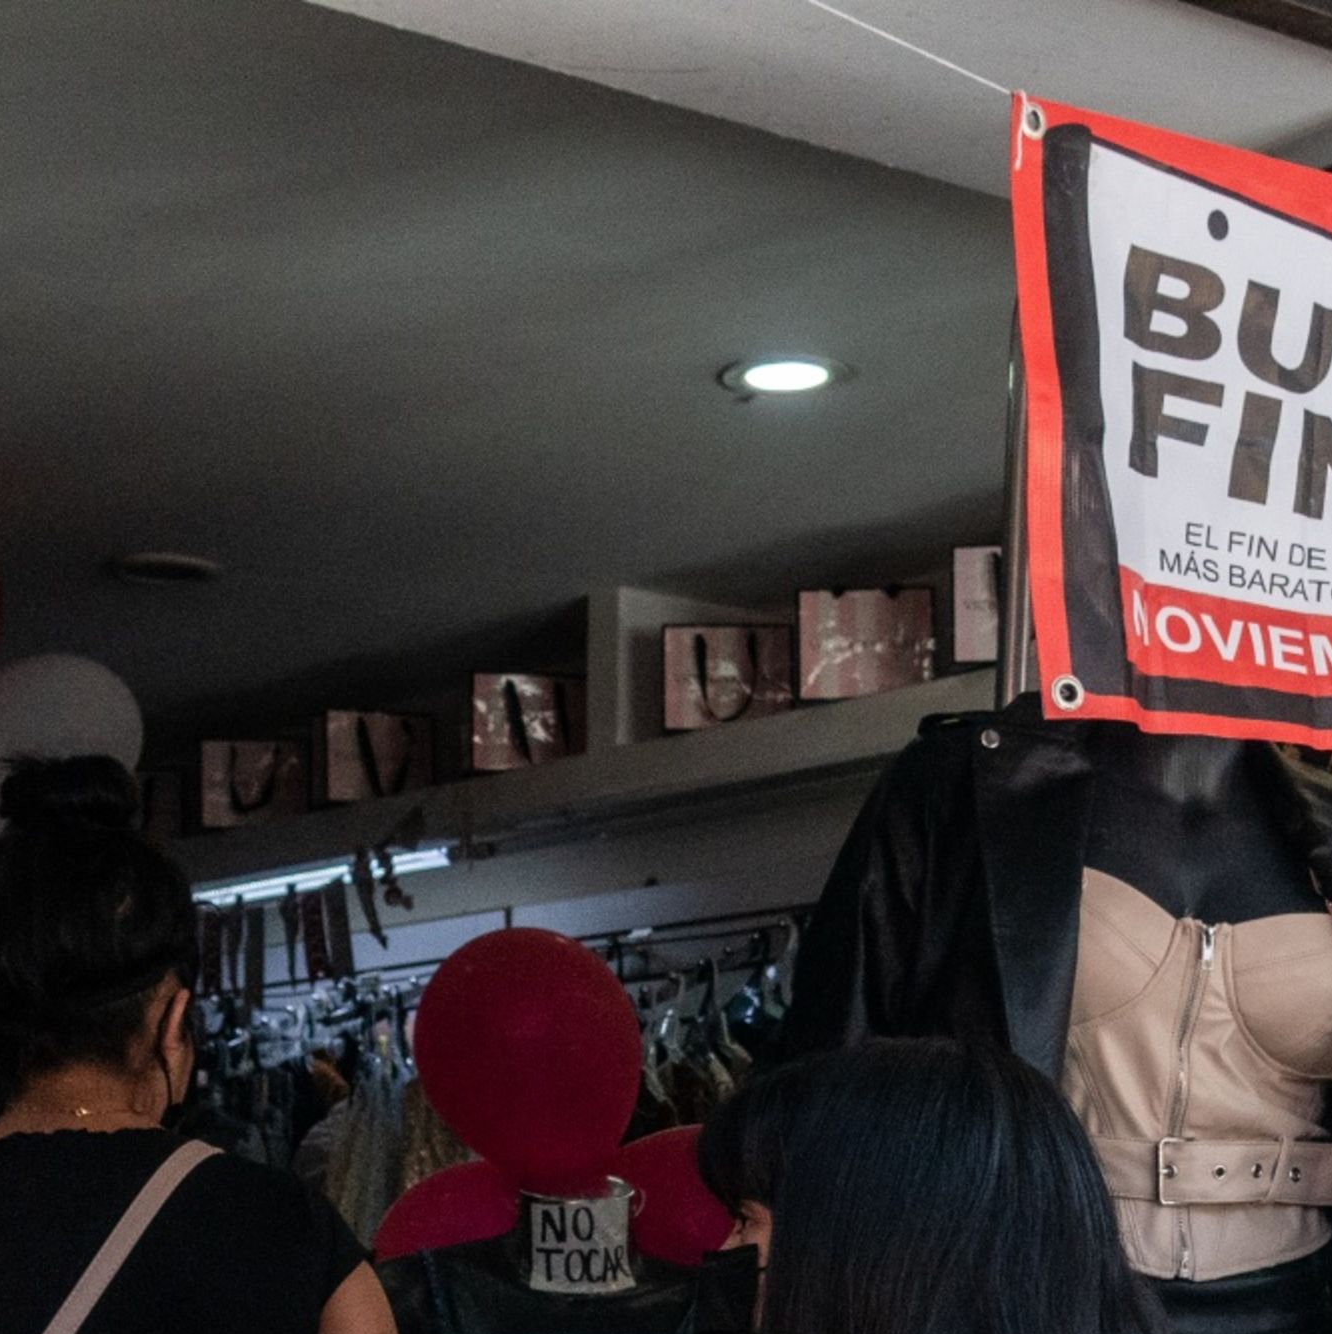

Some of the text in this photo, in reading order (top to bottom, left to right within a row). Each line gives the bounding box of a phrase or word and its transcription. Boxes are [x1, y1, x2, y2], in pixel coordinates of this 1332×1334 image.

[1184, 521, 1219, 551] EL
[1227, 530, 1279, 562] FIN
[1288, 543, 1328, 571] DE
[1158, 548, 1220, 583] MÁS
[541, 1205, 595, 1243] NO
[536, 1245, 631, 1284] TOCAR
